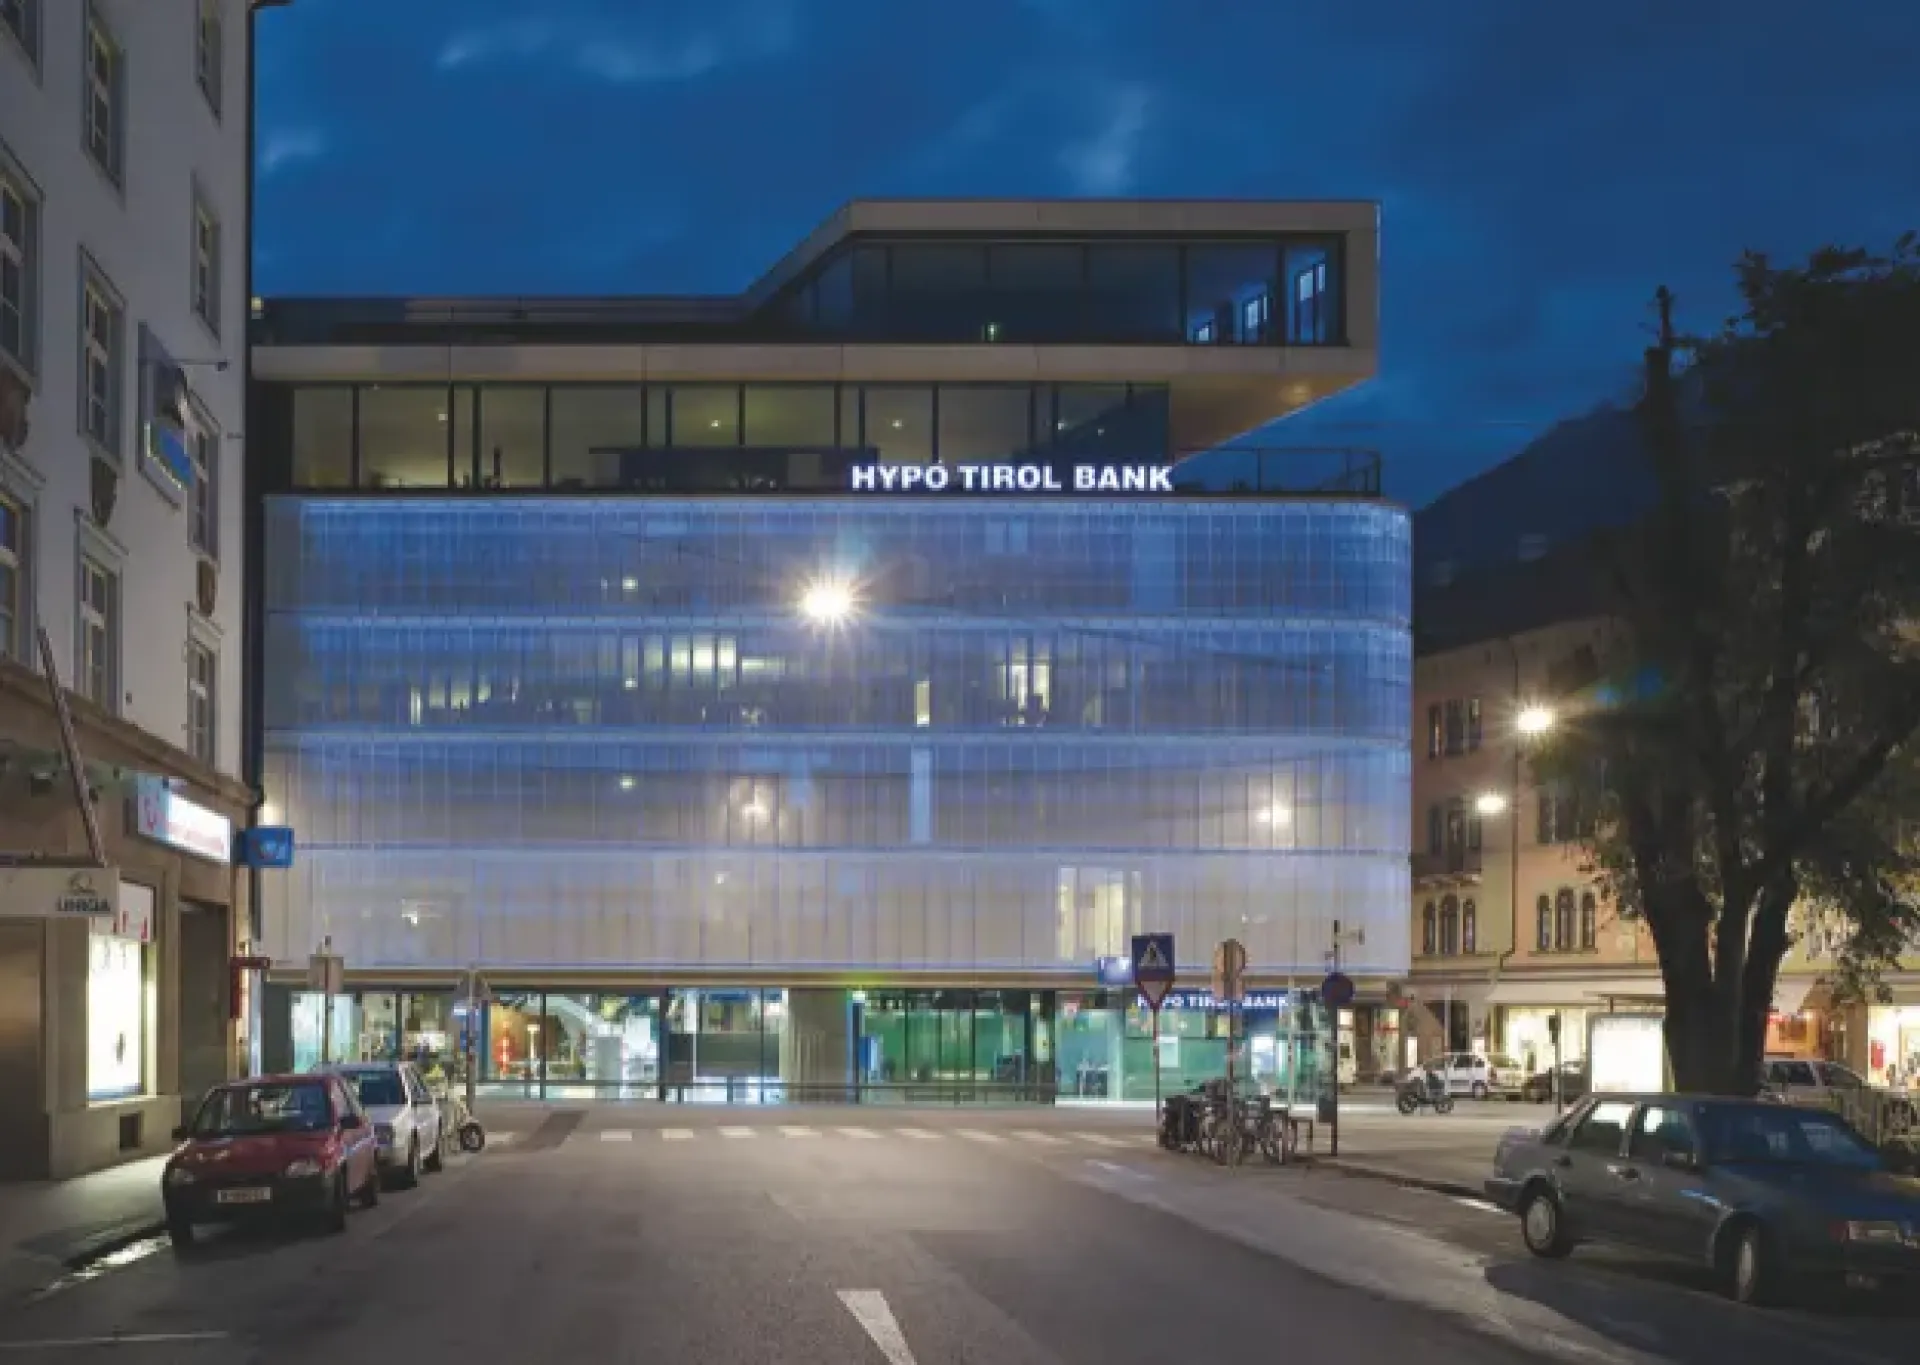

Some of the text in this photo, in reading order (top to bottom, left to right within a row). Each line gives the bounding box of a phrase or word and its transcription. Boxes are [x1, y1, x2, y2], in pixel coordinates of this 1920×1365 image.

[851, 465, 1172, 491] HYPO TIROL BANK
[1137, 993, 1184, 1007] HPO
